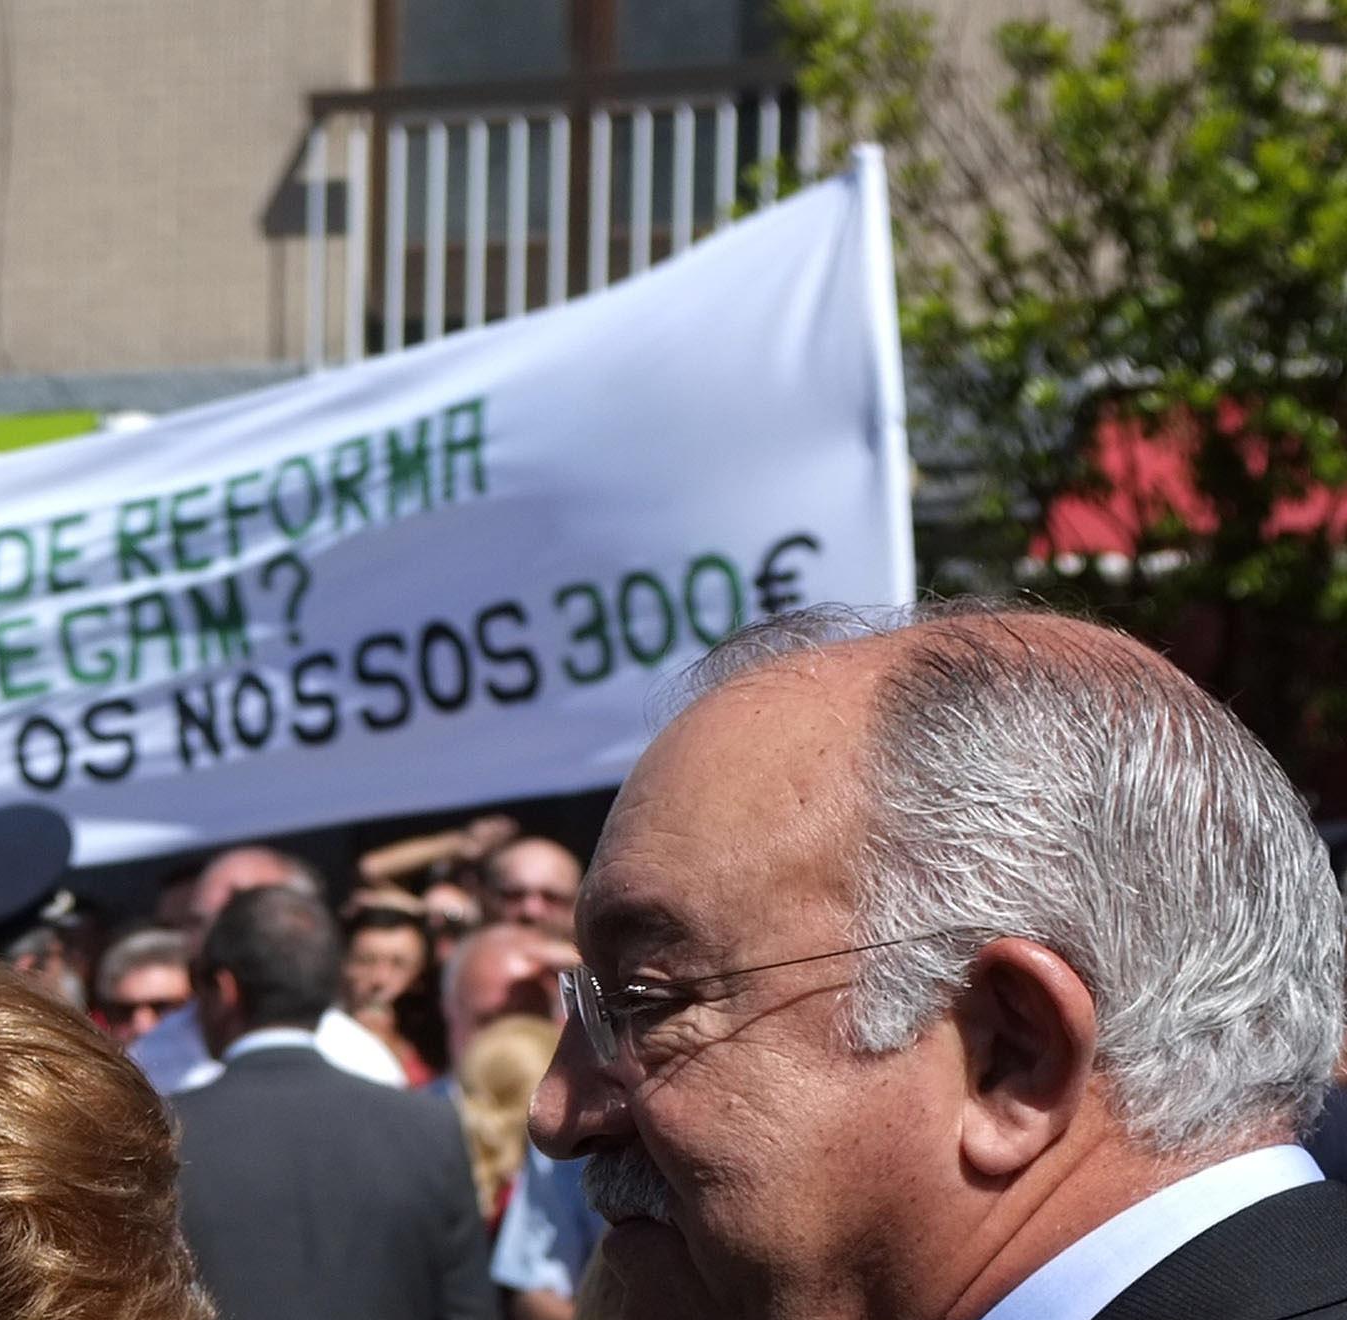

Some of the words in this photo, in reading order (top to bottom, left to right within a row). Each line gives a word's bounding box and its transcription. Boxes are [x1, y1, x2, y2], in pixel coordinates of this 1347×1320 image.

[112, 396, 488, 582] REFORMA
[16, 698, 138, 792] OS
[174, 602, 542, 769] NOSSOS
[553, 533, 821, 687] 300€
